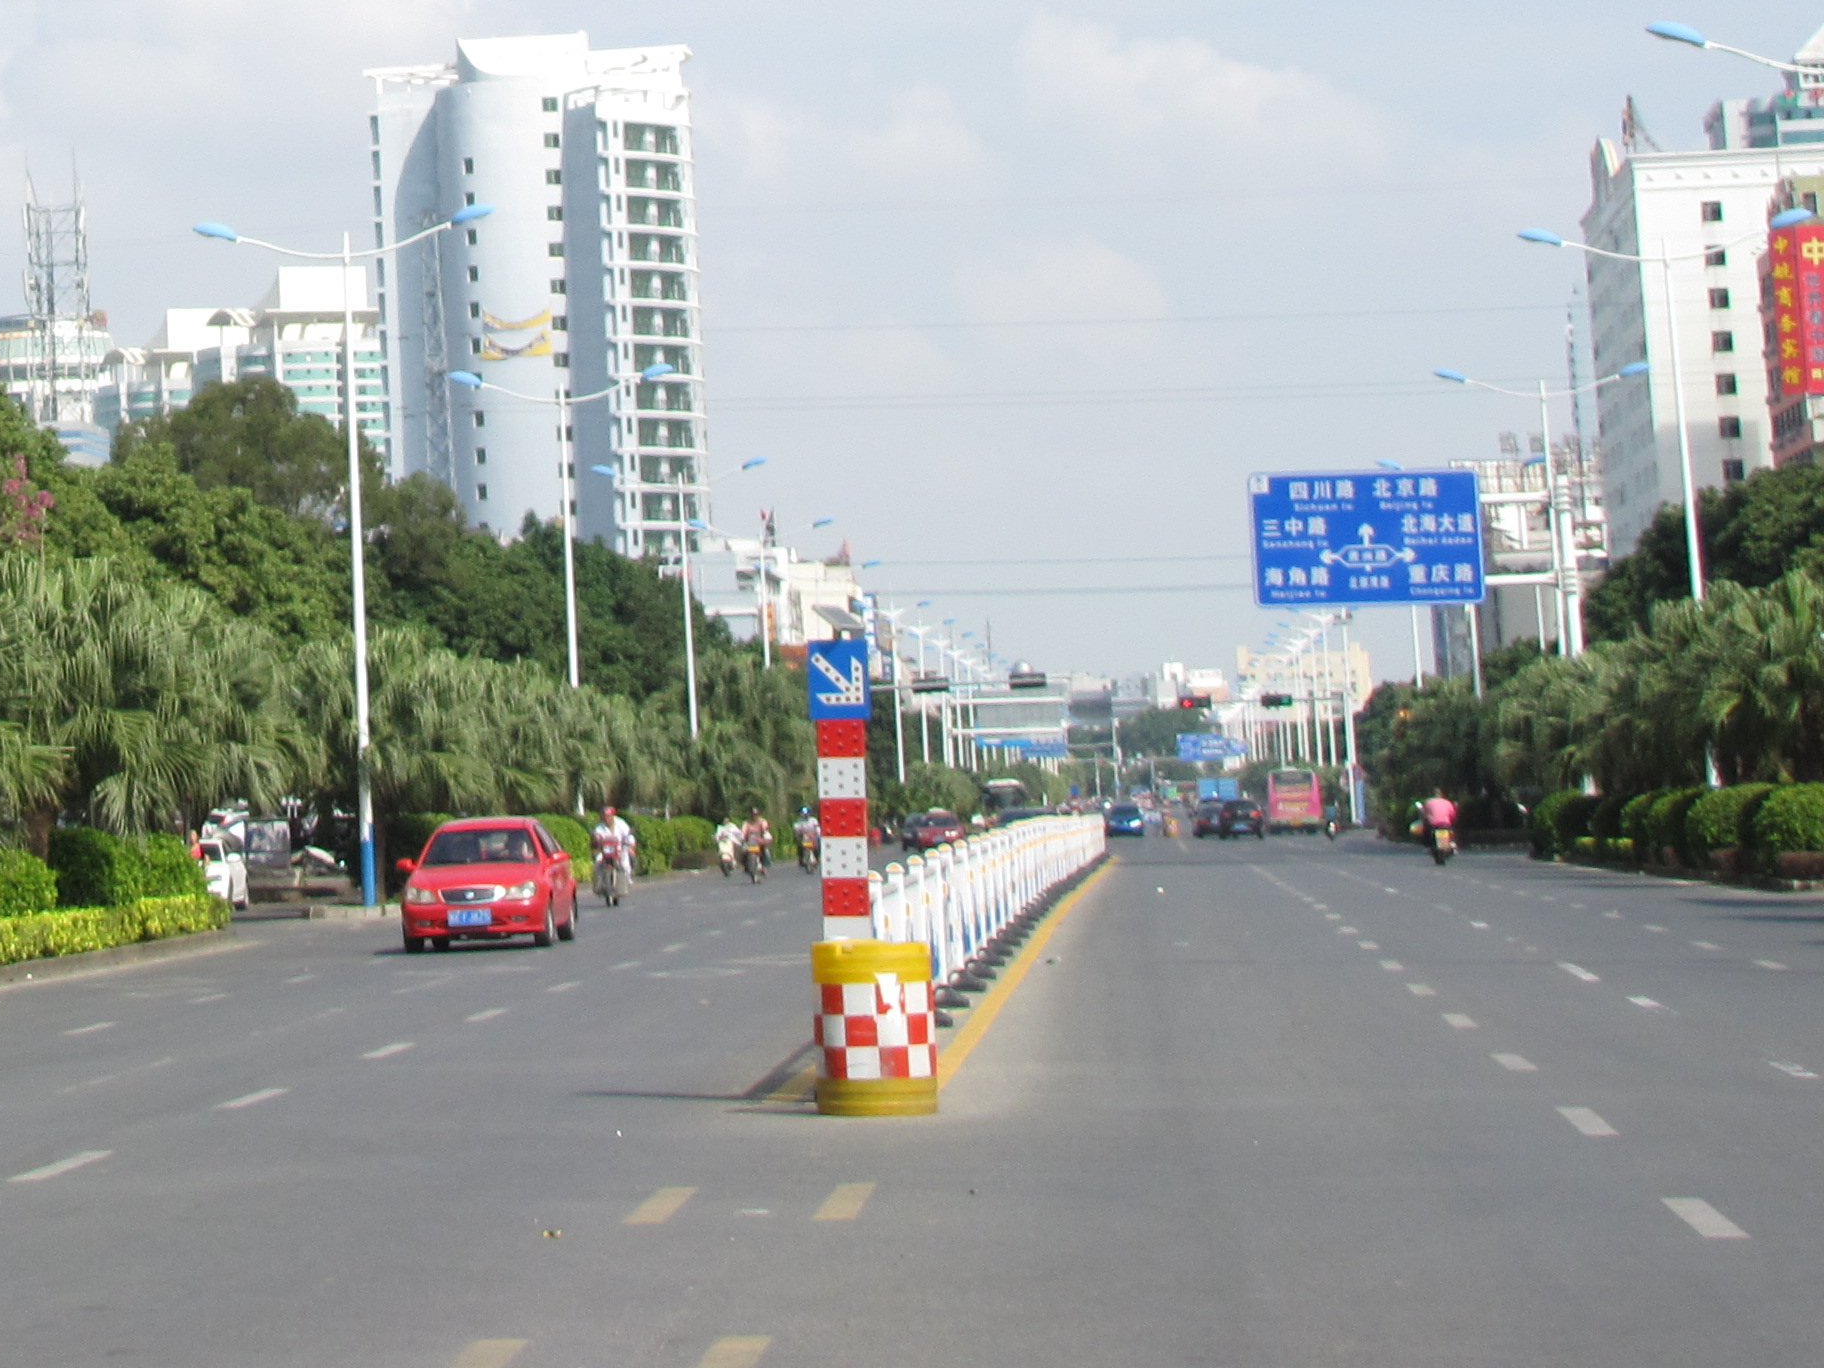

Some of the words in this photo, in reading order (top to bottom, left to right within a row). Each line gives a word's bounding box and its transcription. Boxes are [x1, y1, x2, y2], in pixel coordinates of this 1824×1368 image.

[1289, 480, 1354, 500] 四川路
[1373, 477, 1438, 498] 北京路
[1262, 516, 1326, 537] 三中路
[1401, 513, 1474, 533] 北海大道
[1265, 566, 1330, 586] 海角路
[1408, 563, 1474, 583] 重庆路
